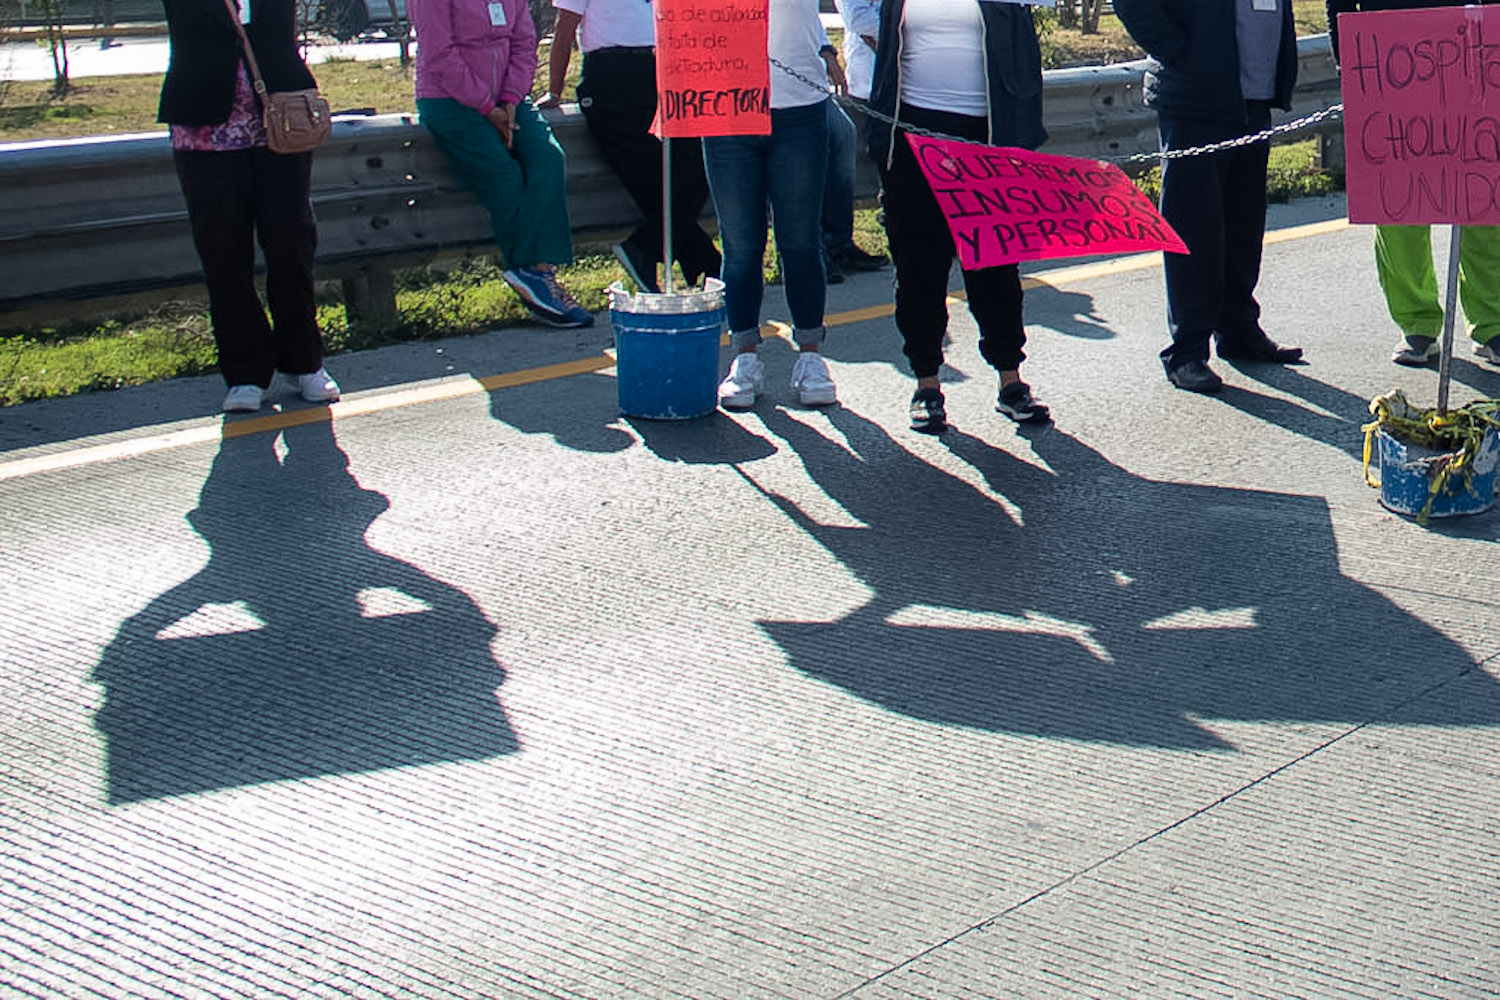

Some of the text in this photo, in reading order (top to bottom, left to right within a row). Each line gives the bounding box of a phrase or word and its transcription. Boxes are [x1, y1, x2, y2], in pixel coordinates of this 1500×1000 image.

[704, 33, 728, 49] de
[665, 87, 769, 120] DIRECTORA
[919, 143, 1138, 196] QUEREMOS
[935, 187, 1161, 226] INSUMOS
[957, 227, 980, 262] Y
